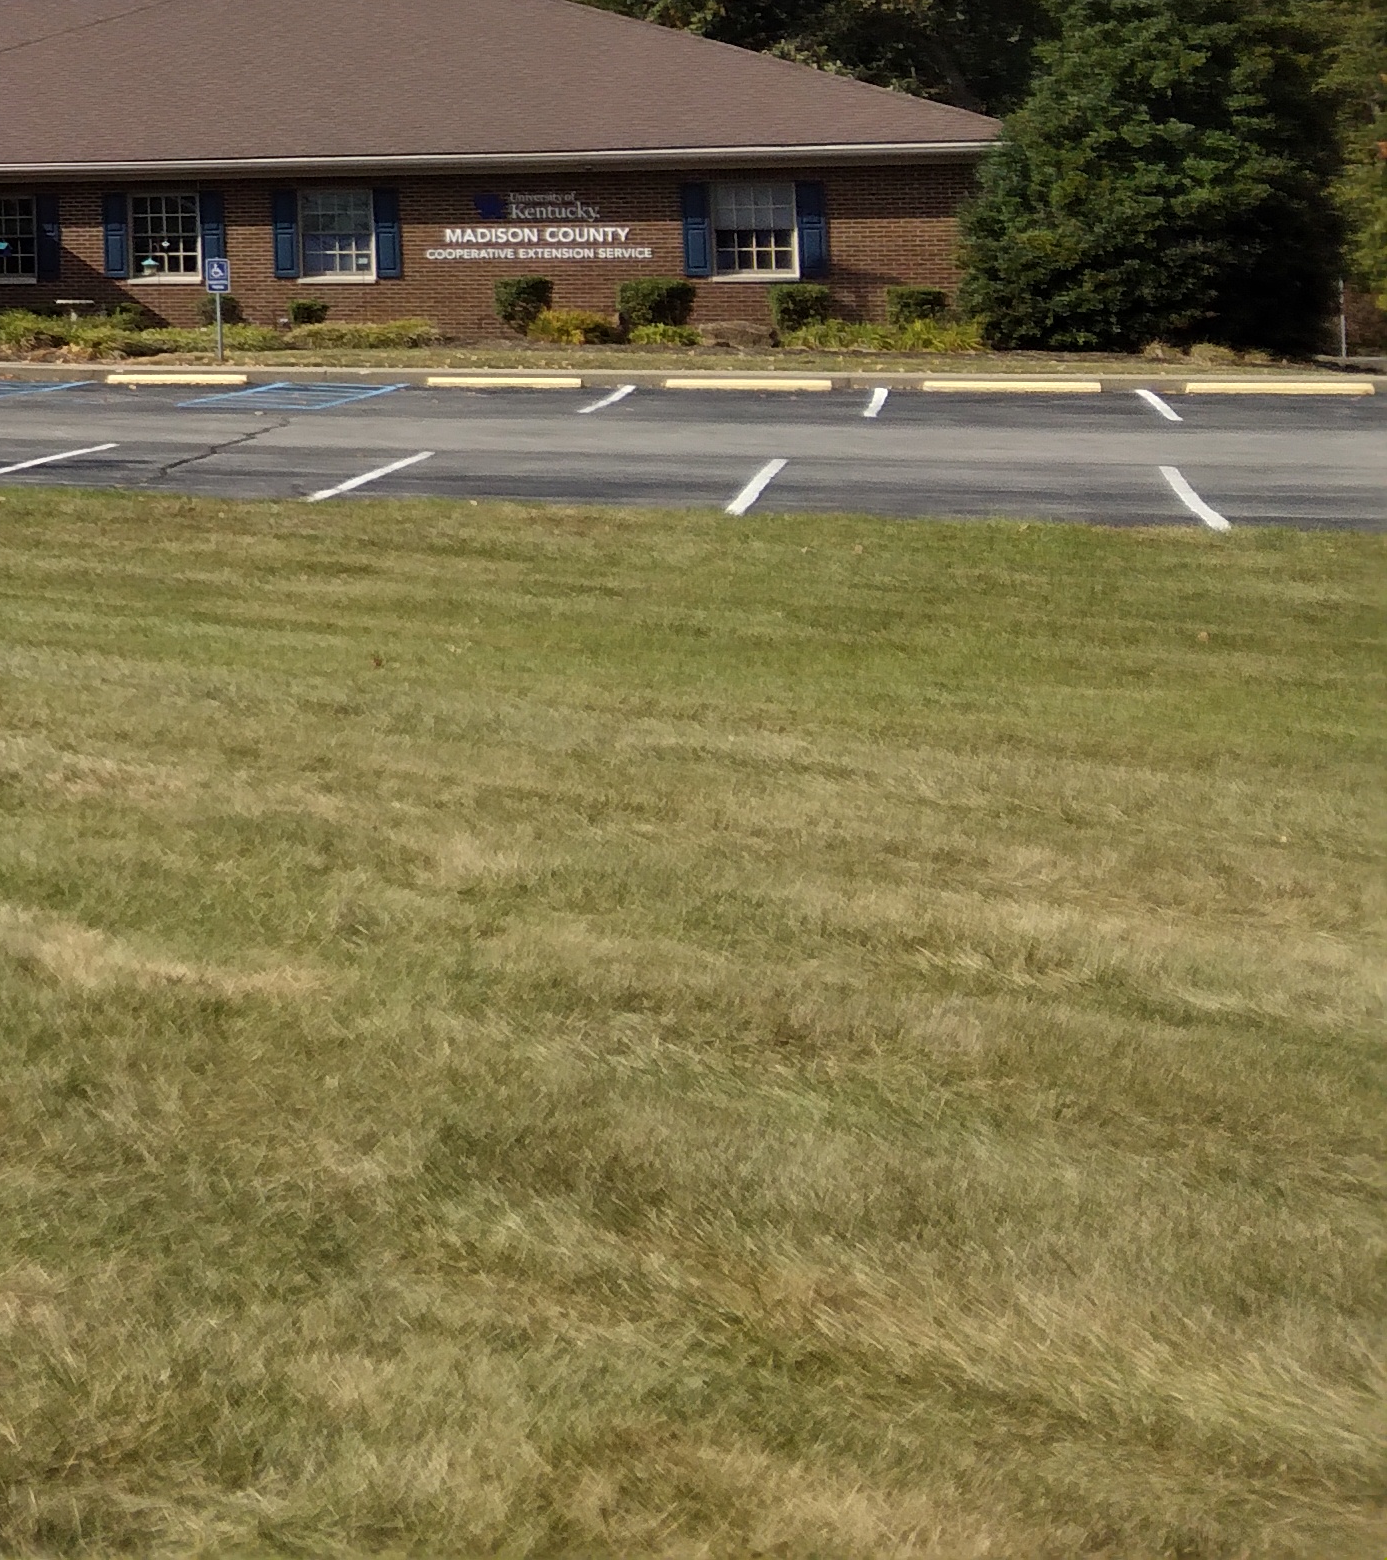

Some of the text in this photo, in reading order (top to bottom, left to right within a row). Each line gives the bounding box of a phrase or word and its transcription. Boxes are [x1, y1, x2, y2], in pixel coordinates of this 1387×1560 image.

[509, 190, 577, 203] University of
[510, 201, 597, 221] Kentucky
[445, 227, 630, 243] MADISON COUNTY
[426, 247, 653, 259] COOPERATIVE EXTENSION SERVICE
